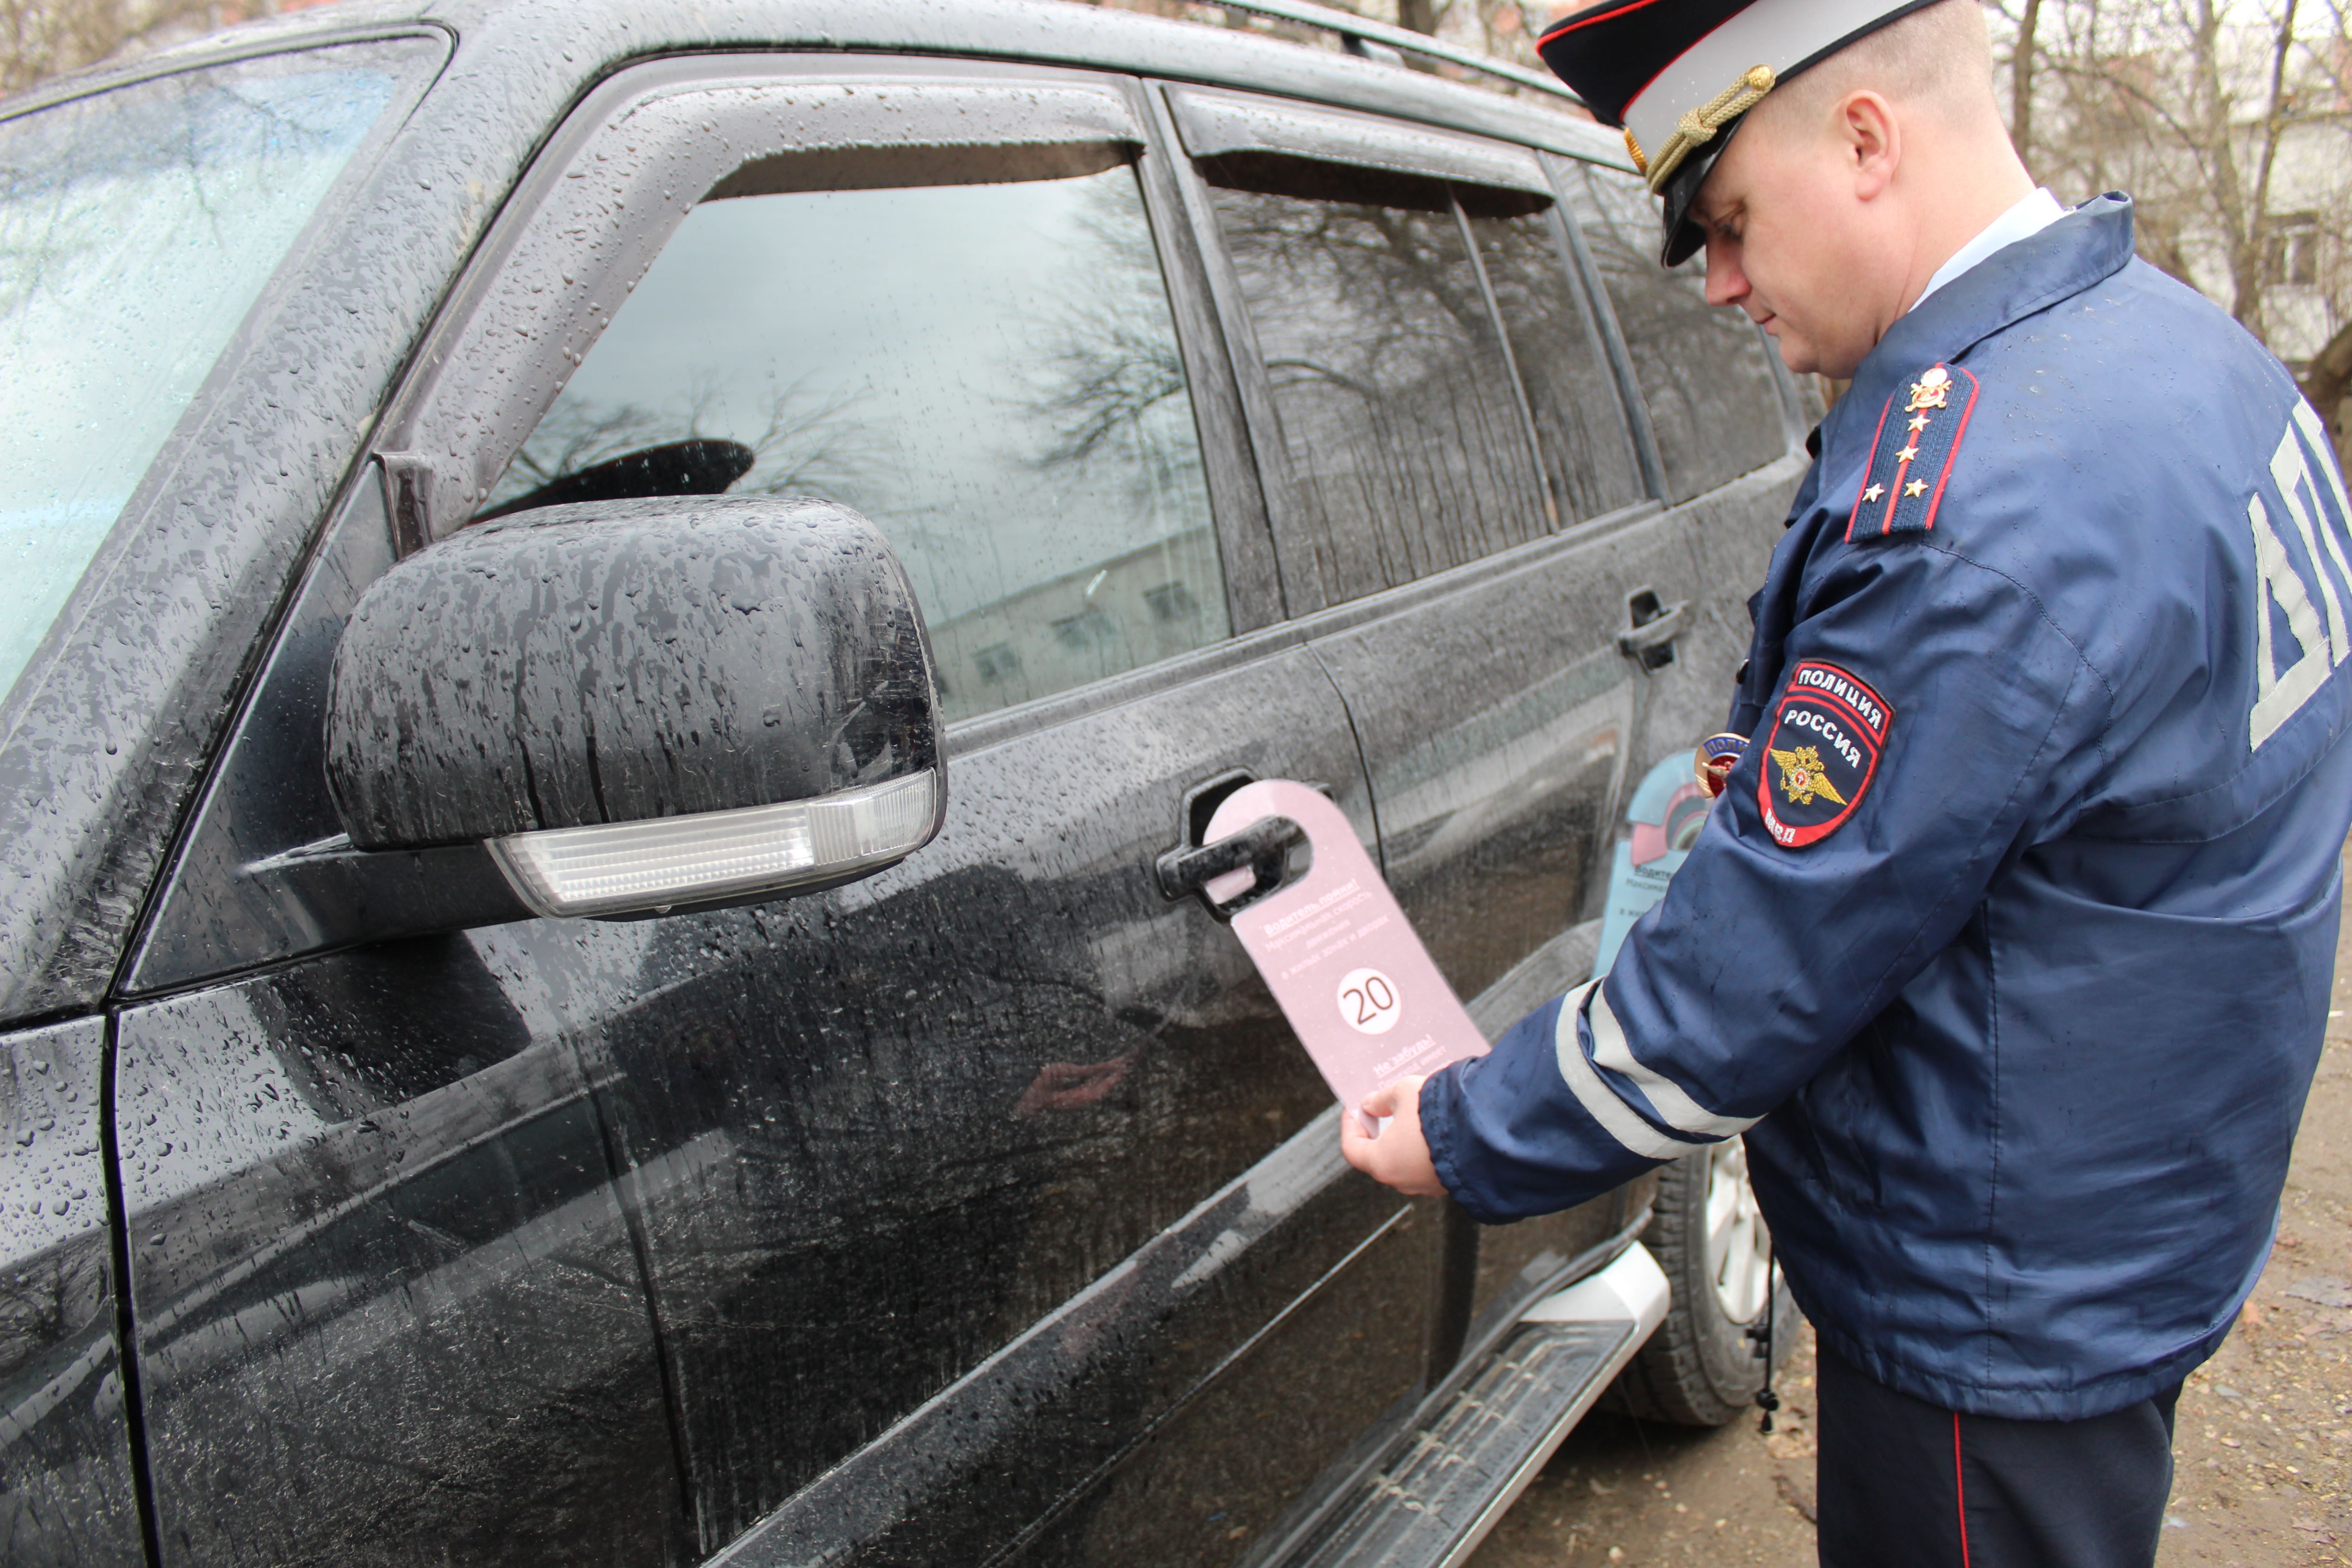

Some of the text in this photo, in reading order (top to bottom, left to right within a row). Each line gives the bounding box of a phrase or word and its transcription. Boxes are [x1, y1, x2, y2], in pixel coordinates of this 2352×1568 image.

[1798, 669, 1882, 730] ПОЛИЦИЯ
[1784, 709, 1862, 769] РОССИЯ
[1764, 808, 1796, 844] МВД
[1318, 877, 1358, 905] помни!
[1342, 975, 1393, 1024] 20
[1372, 1032, 1435, 1075] Не забудь!
